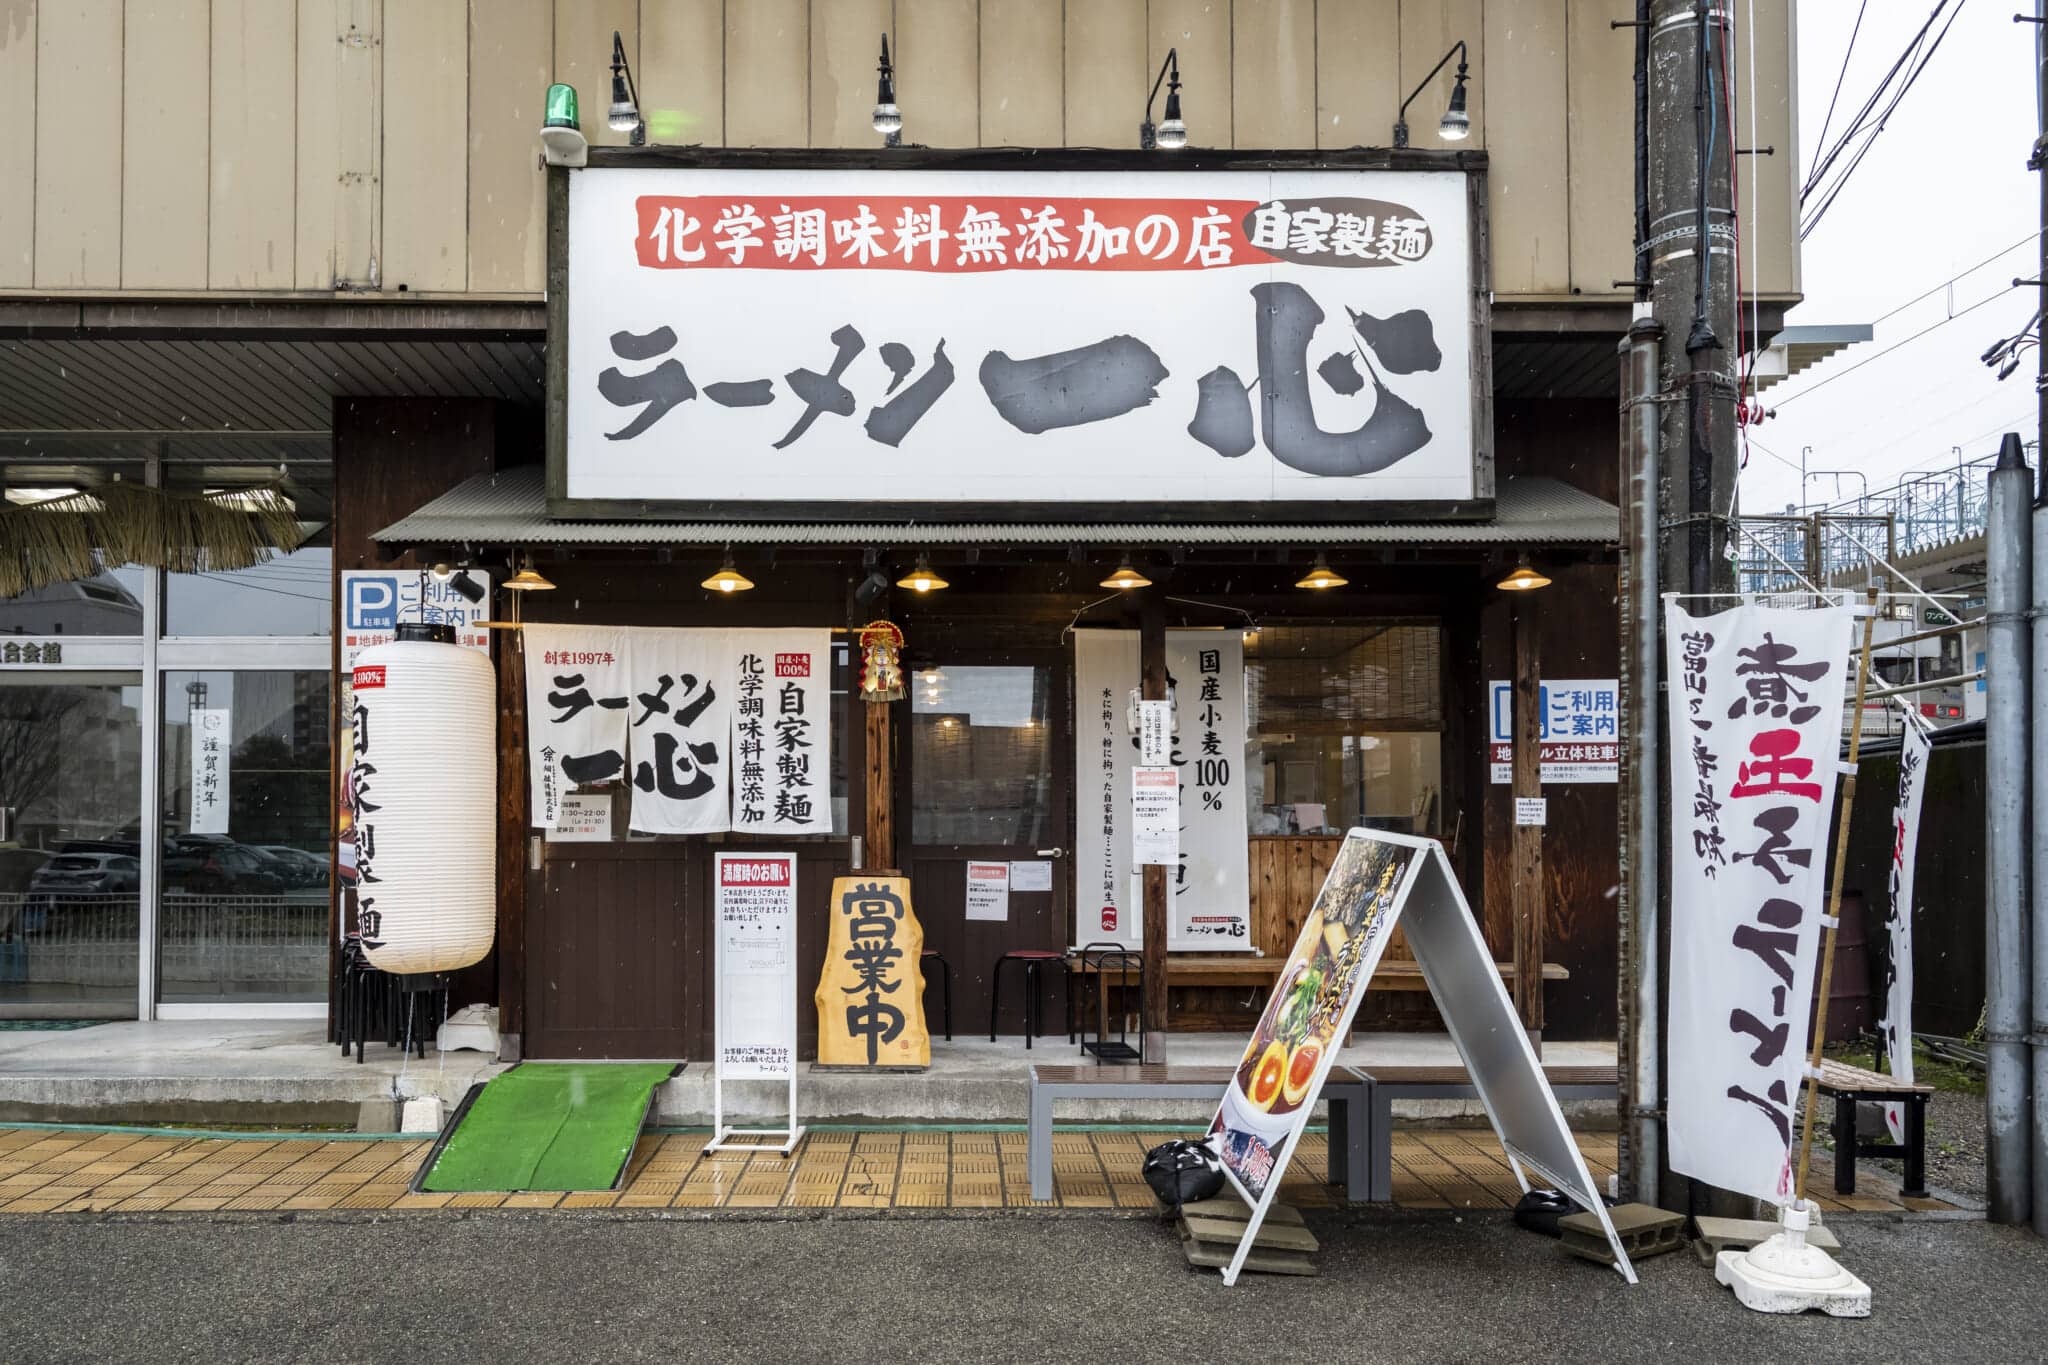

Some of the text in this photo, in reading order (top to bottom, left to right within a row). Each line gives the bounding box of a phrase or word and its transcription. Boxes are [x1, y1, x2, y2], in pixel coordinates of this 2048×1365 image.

[649, 203, 1233, 268] 化学調味料無添加の店
[1249, 201, 1430, 263] 自家製麺
[598, 282, 1443, 477] ラーメン一心
[363, 616, 391, 627] 駐車場
[0, 641, 63, 664] 合会館
[544, 651, 616, 666] 創業1997年
[776, 655, 809, 665] 国産小麦
[353, 670, 383, 686] 100%
[777, 665, 809, 676] 100%
[548, 672, 717, 729] ラーメン
[1551, 690, 1618, 712] ご利用
[738, 653, 766, 824] 化学調味料無添加
[774, 681, 815, 825] 自家製麺
[1540, 745, 1618, 761] ル立体駐車
[202, 735, 219, 808] 謹賀新年
[561, 731, 719, 801] 一心
[723, 863, 788, 882] 満席時のお願い
[1187, 922, 1246, 938] ラーメン一心
[840, 882, 905, 1065] 営業中
